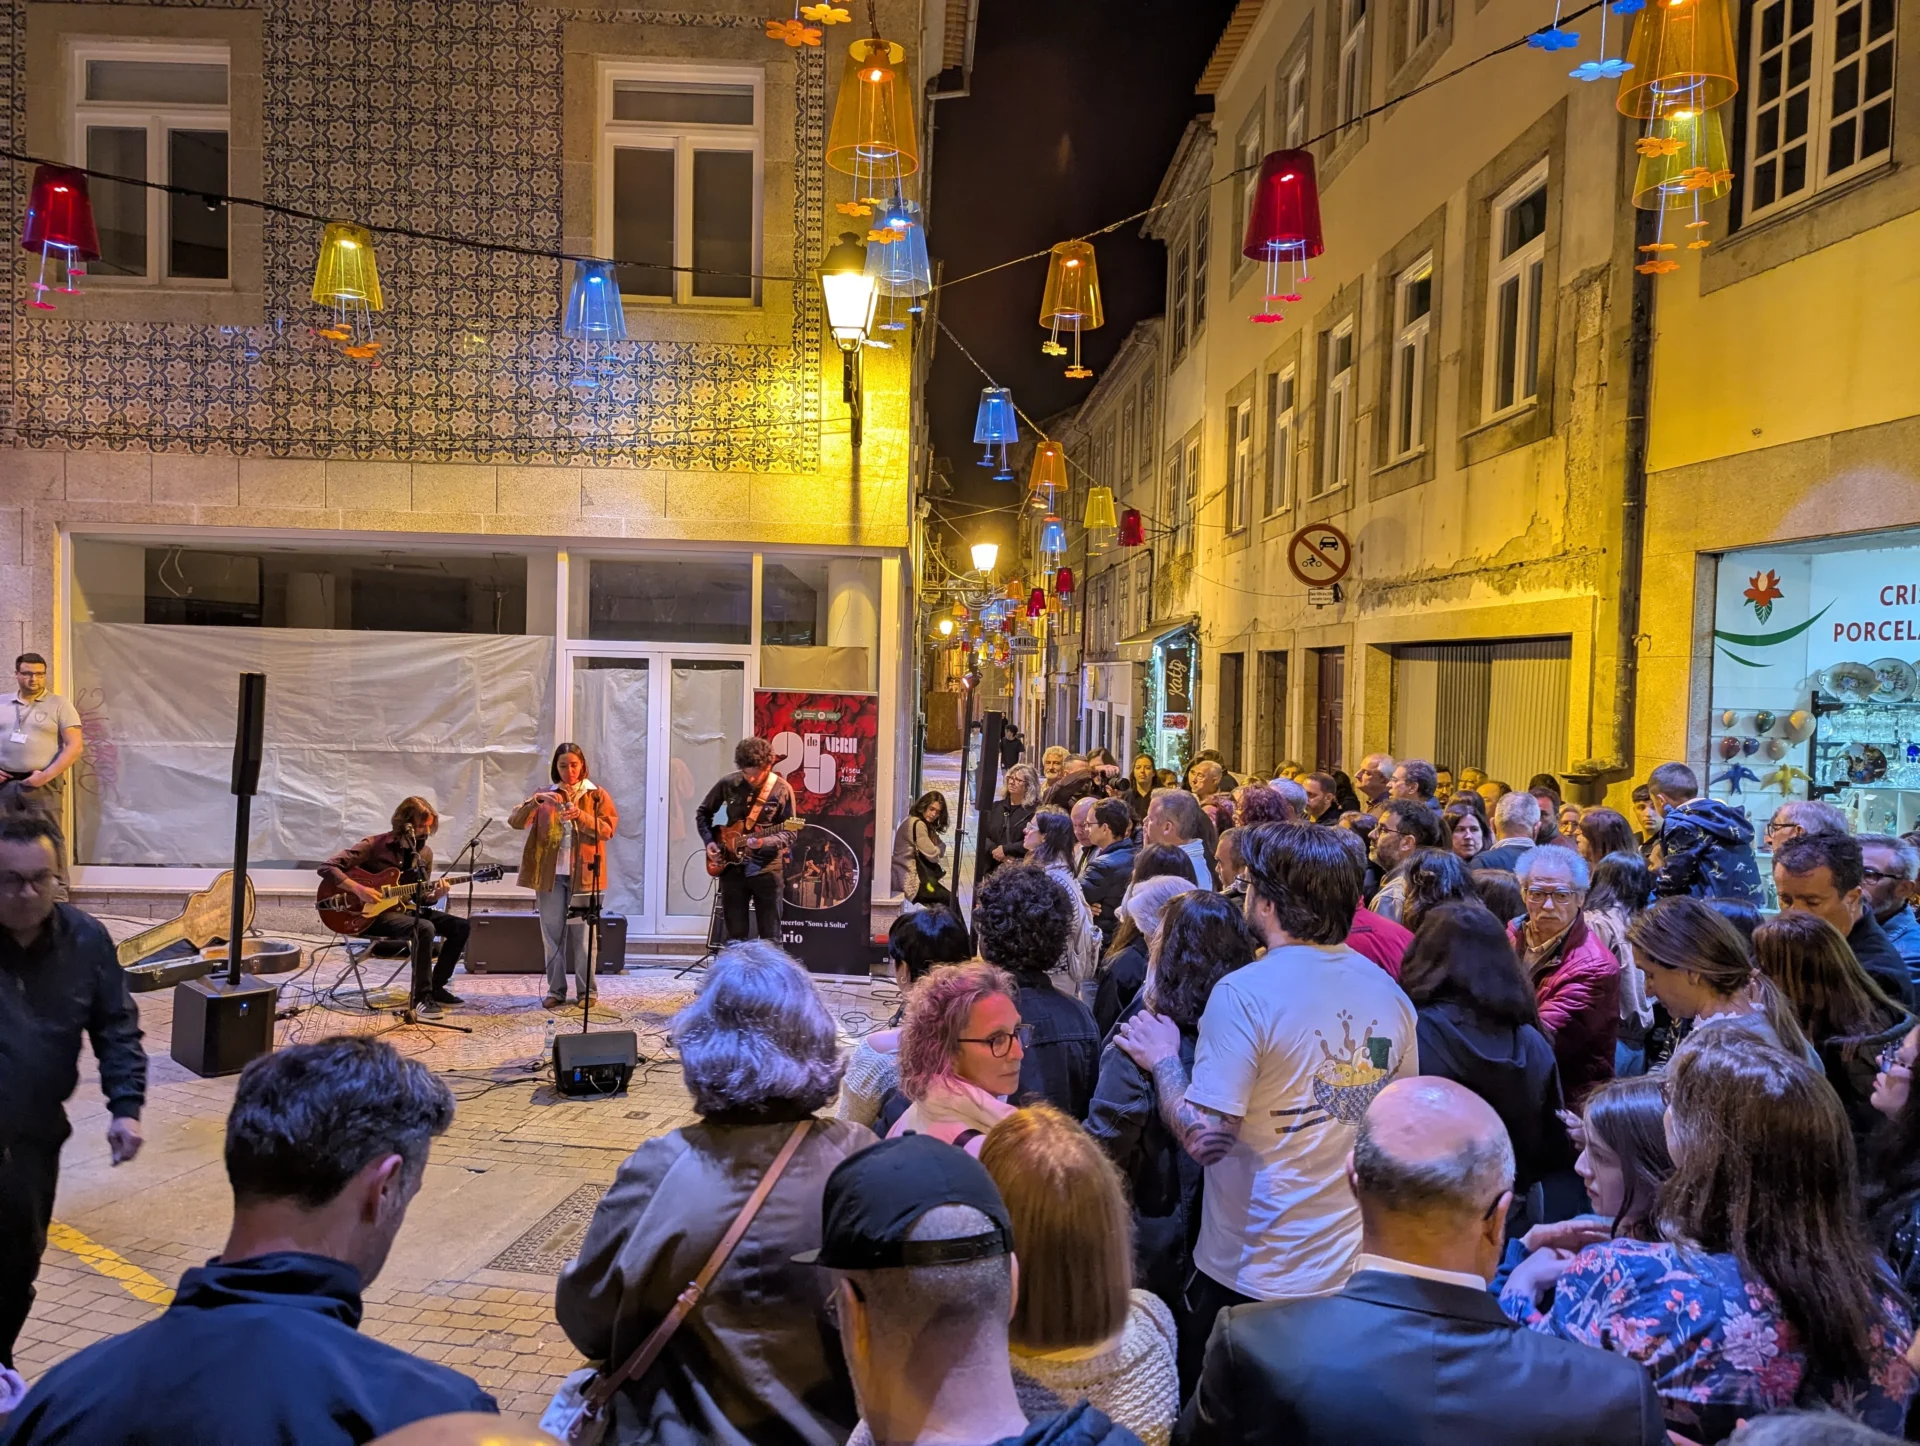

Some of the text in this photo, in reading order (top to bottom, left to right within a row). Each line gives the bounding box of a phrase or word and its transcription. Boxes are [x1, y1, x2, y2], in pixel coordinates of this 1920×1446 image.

[1879, 584, 1920, 606] CRI
[1833, 620, 1920, 642] PORCEL
[1167, 659, 1187, 698] Katy
[771, 731, 836, 794] 25
[807, 736, 818, 747] de
[841, 766, 861, 774] Viseu
[841, 775, 857, 783] 2026
[781, 930, 804, 944] rio
